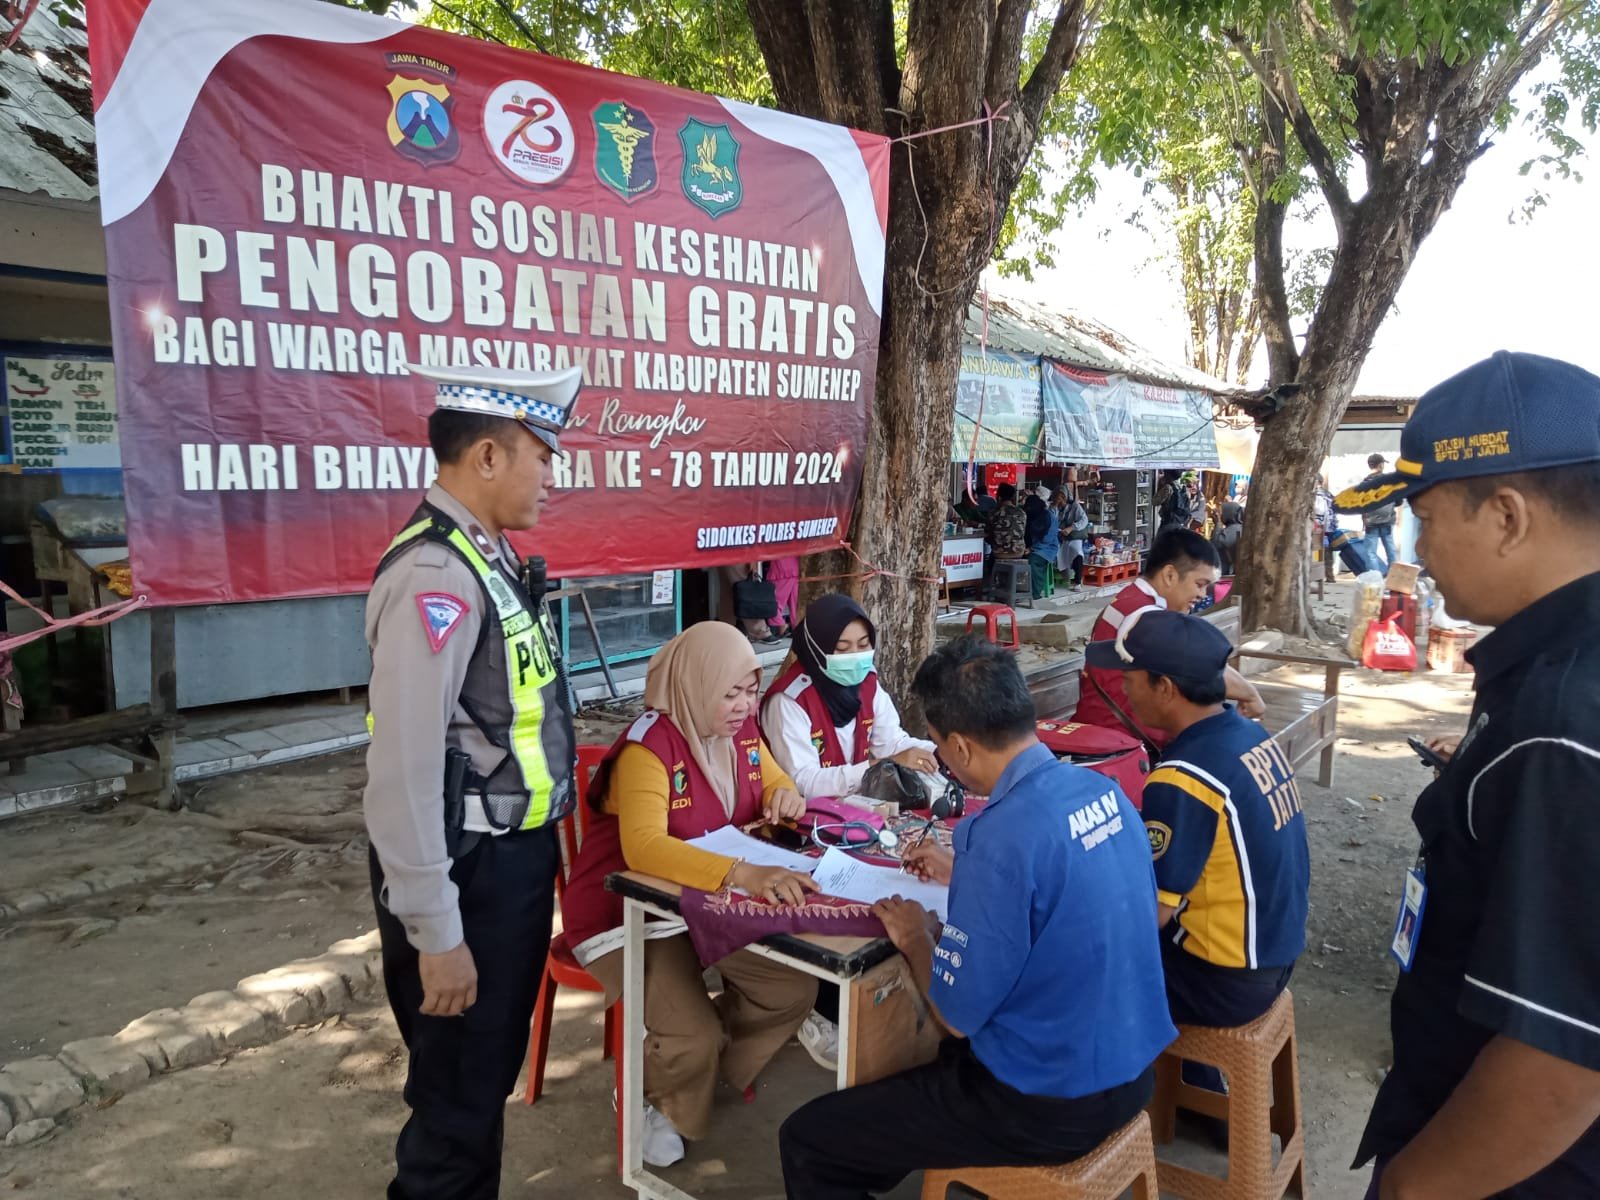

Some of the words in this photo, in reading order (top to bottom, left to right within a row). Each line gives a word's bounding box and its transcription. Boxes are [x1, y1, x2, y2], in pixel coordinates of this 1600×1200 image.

[391, 53, 419, 65] JAWA
[420, 56, 450, 75] TIMUR
[512, 148, 564, 167] PRESISI
[261, 163, 455, 245] BHAKTI
[470, 194, 623, 267] SOSIAL
[634, 221, 819, 293] KESEHATAN
[173, 222, 667, 343] PENGOBATAN
[688, 285, 856, 361] GRATIS
[154, 315, 257, 368] BAGI
[267, 321, 410, 376] WARGA
[418, 333, 625, 389] MASYARAKAT
[633, 351, 771, 397] KABUPATEN
[776, 362, 862, 402] SUMENEP
[960, 355, 1025, 379] ANDAWA
[10, 399, 63, 409] RAWON
[73, 400, 106, 410] TEH
[11, 411, 54, 421] SOTO
[12, 422, 71, 432] CAMPUR
[598, 397, 707, 449] Rangka
[13, 434, 63, 444] PECEL
[1434, 437, 1466, 452] DITJEN
[1469, 431, 1509, 446] HUBDAT
[14, 446, 69, 456] LODEH
[180, 443, 299, 491] HARI
[605, 449, 642, 489] KE
[650, 467, 662, 477] -
[670, 450, 702, 488] 78
[711, 451, 787, 488] TAHUN
[793, 451, 843, 484] 2024
[696, 526, 757, 549] SIDOKKES
[758, 521, 796, 544] POLRES
[671, 797, 692, 810] EDI
[1068, 799, 1107, 841] AKAS
